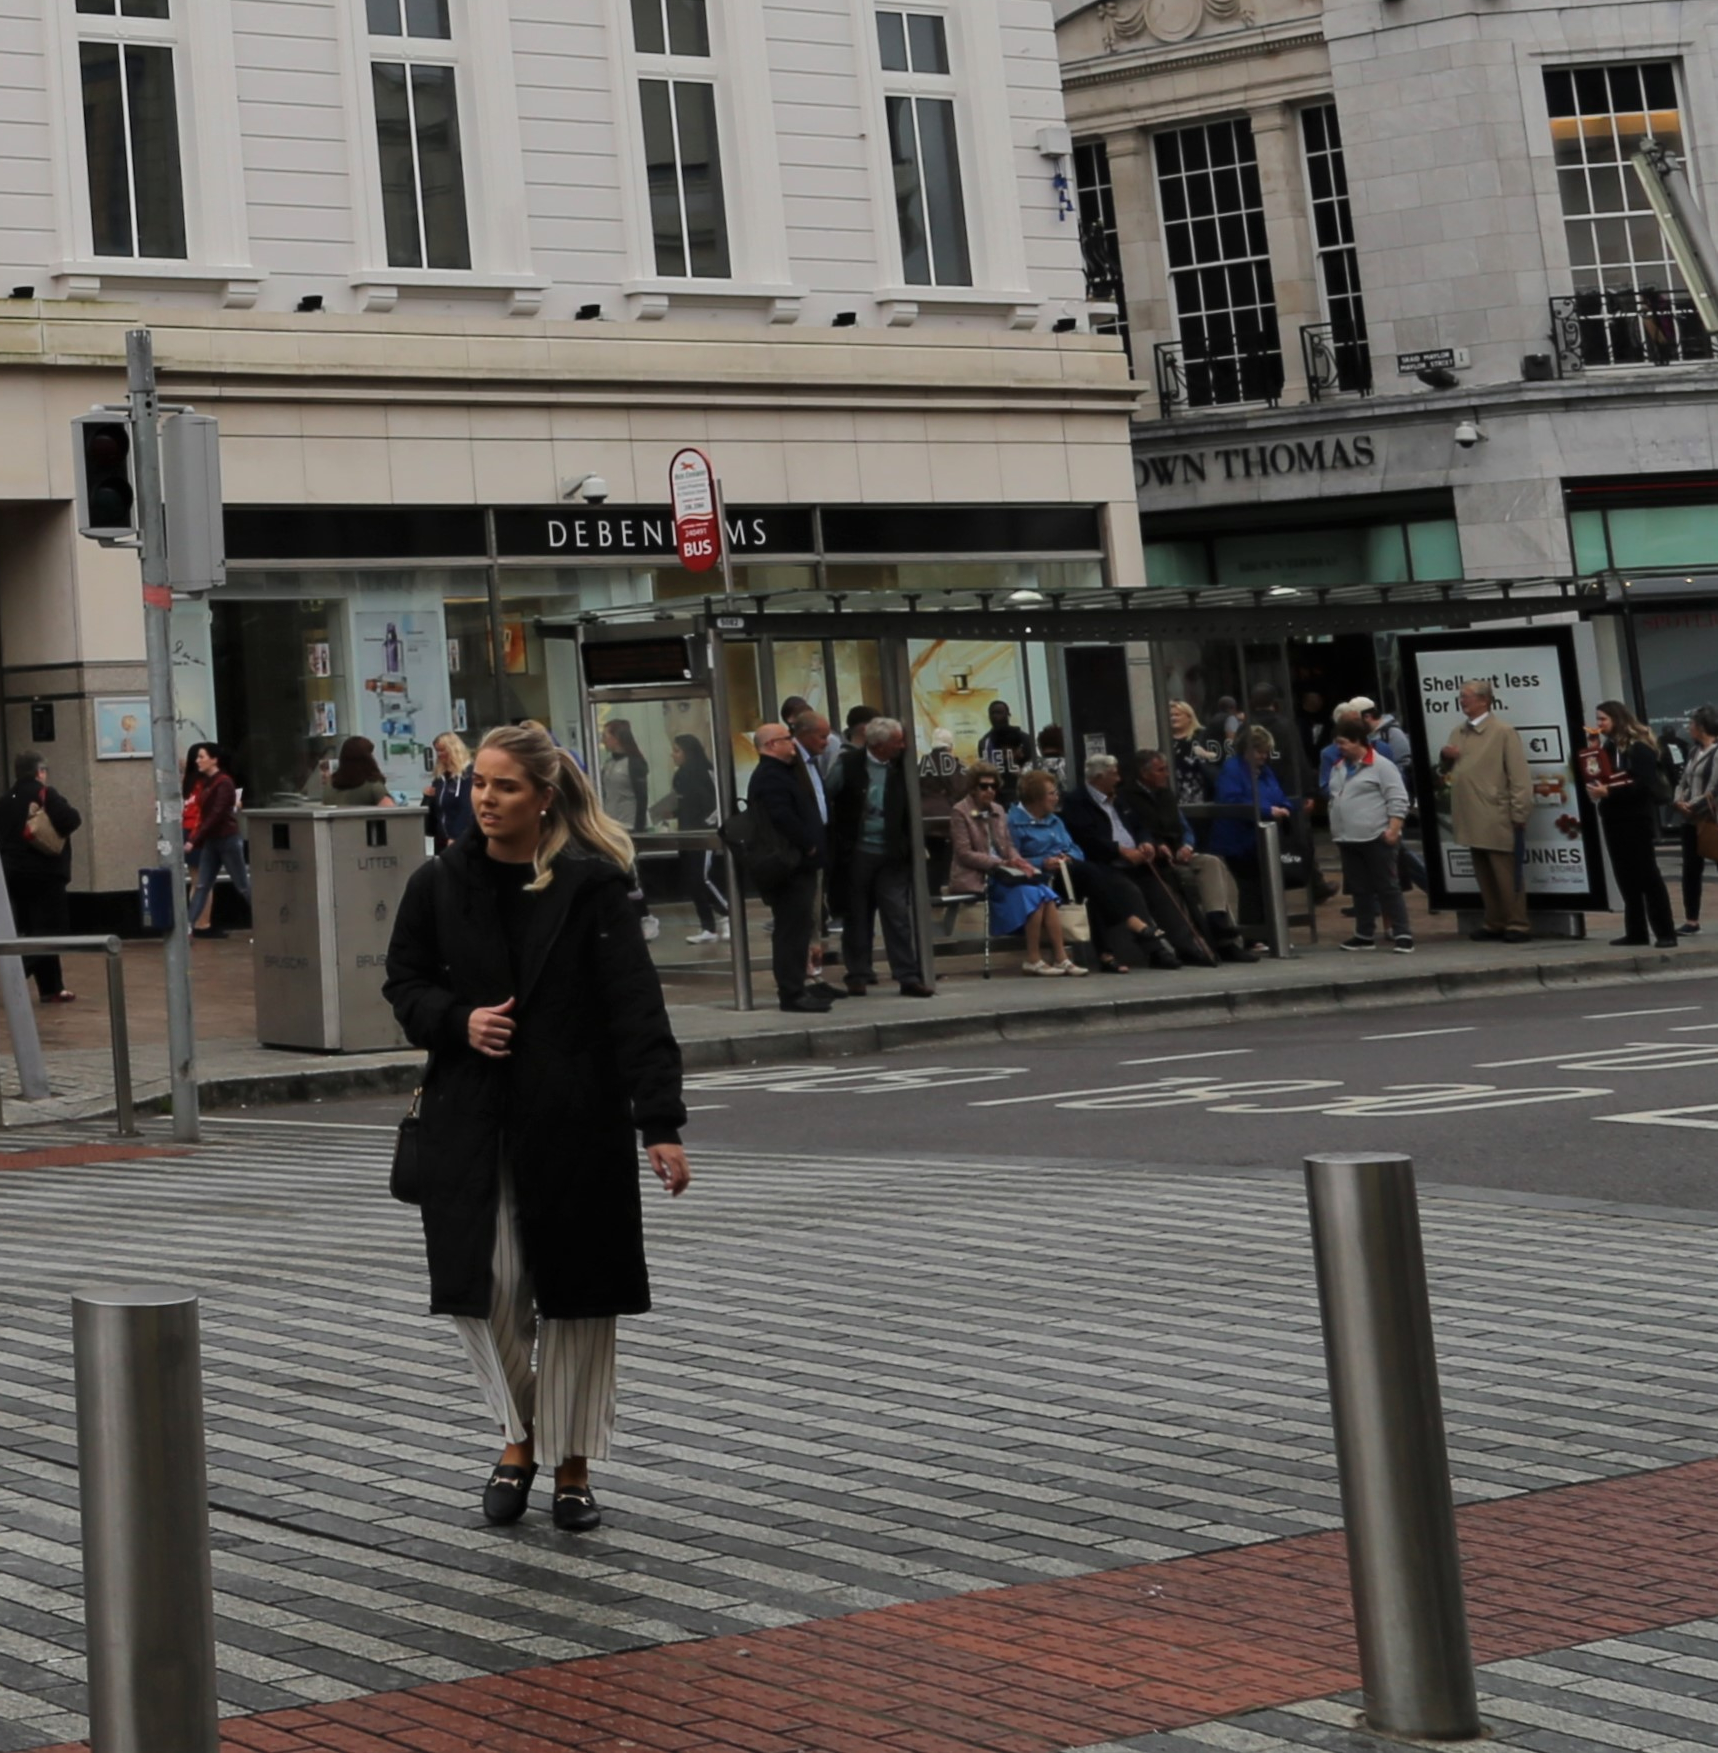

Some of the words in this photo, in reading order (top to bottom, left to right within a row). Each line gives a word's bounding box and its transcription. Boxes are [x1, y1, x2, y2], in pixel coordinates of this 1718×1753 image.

[1133, 452, 1207, 488] OWN
[1215, 435, 1376, 480] THOMAS
[548, 519, 767, 547] DEBENMS
[683, 539, 712, 557] BUS
[1505, 673, 1540, 688] less
[1425, 698, 1449, 713] for
[1529, 738, 1548, 753] €1
[357, 856, 398, 870] LITTER
[1523, 848, 1581, 864] UNNES
[265, 860, 299, 872] LITTER
[356, 954, 387, 968] BRUS
